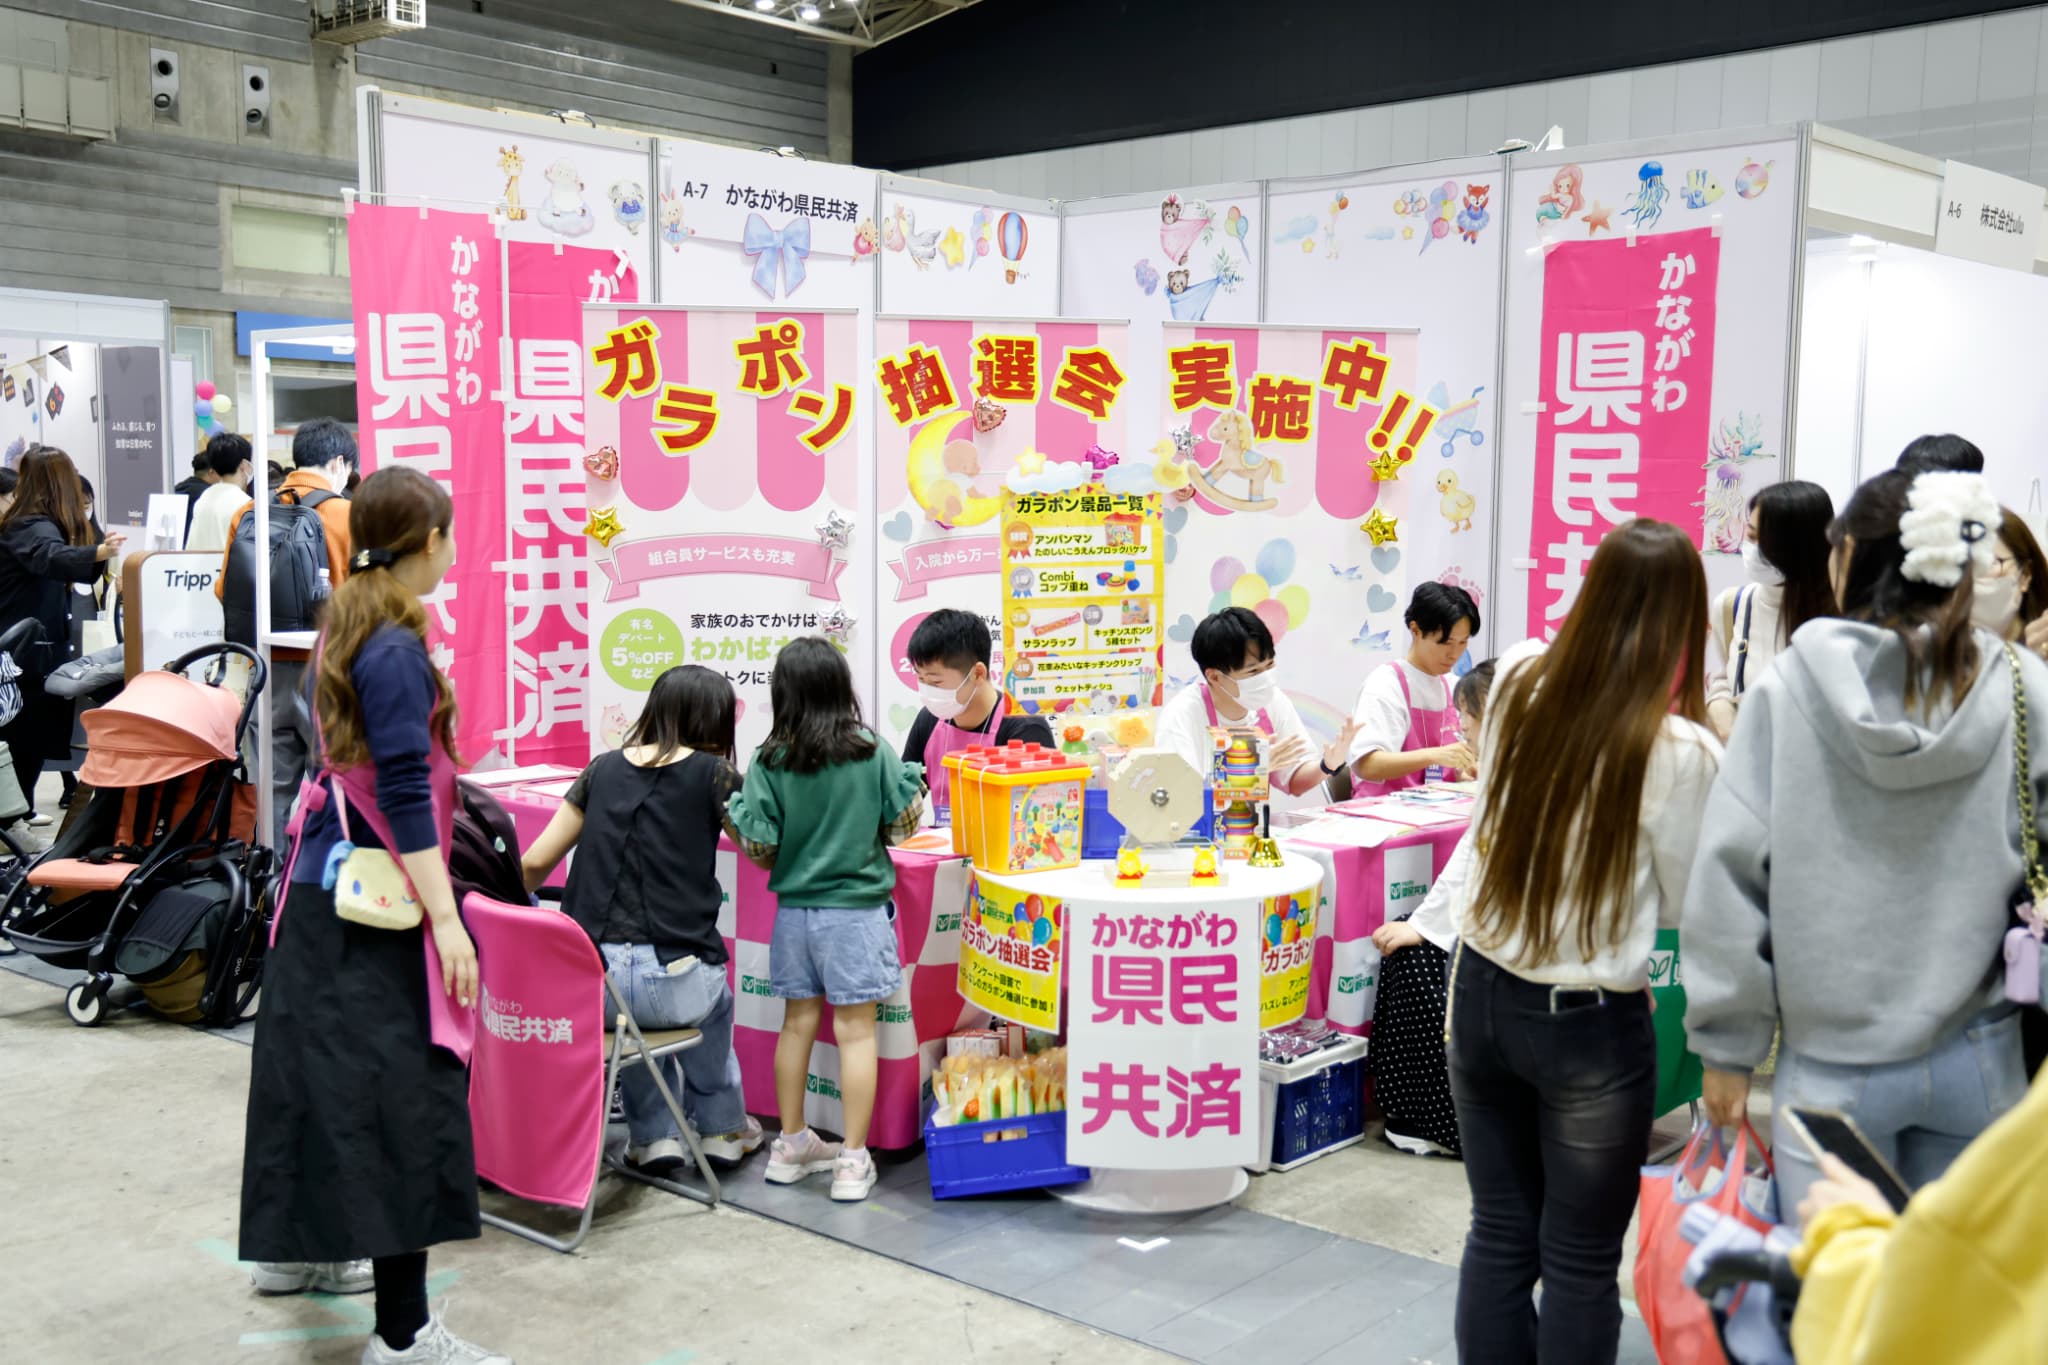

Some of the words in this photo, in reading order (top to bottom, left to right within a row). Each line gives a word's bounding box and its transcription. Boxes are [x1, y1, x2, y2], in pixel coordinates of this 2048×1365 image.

[683, 180, 709, 200] A-7
[726, 181, 859, 224] かながわ県民共済
[1947, 200, 1962, 219] A-6
[450, 235, 484, 406] かながわ
[1651, 252, 1697, 413] かながわ
[593, 320, 855, 452] ガラポン
[881, 335, 1125, 424] 抽選会
[1544, 330, 1645, 641] 県民
[1016, 495, 1144, 514] ガラポン景品一覧
[499, 338, 589, 740] 県民共済
[1034, 534, 1093, 545] アンパンマン
[647, 545, 796, 567] 組合員サービスも充実
[915, 547, 1002, 572] 入院から万一
[164, 569, 212, 592] Tripp
[1039, 571, 1075, 582] Combi
[1039, 582, 1090, 593] コップ重ね
[629, 618, 654, 631] 有名
[1093, 626, 1154, 637] キッチンスポンジ
[617, 632, 666, 644] デパート
[1022, 637, 1077, 649] サランラップ
[611, 647, 674, 668] 5%OFF
[631, 668, 655, 680] など
[1091, 910, 1239, 951] かながわ
[961, 919, 1053, 974] ガラポン抽選会
[1091, 953, 1239, 1026] 県民
[1081, 1061, 1243, 1139] 共済
